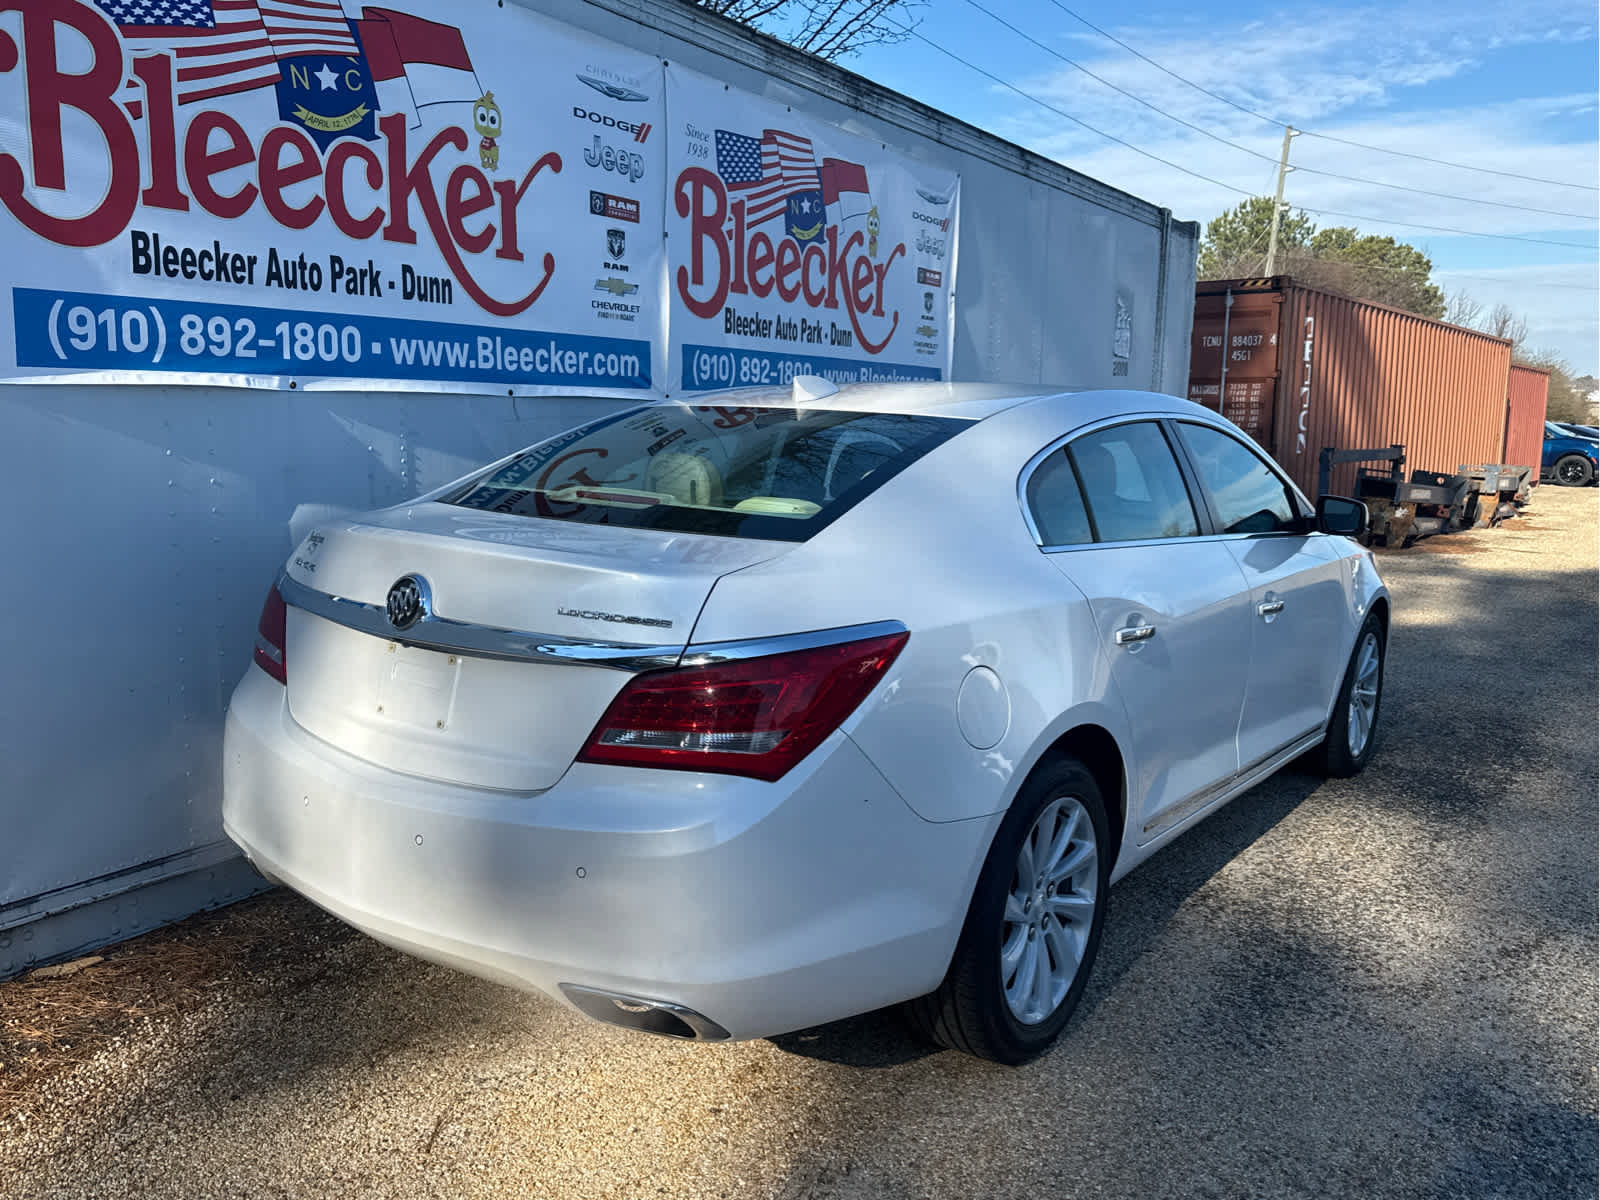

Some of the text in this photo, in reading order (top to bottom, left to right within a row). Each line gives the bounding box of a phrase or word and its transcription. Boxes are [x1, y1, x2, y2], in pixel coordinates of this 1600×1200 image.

[573, 106, 642, 135] DODGE
[685, 123, 709, 143] Since
[0, 0, 563, 317] Bleecker
[583, 134, 645, 183] Jeep
[687, 142, 709, 160] 1938
[607, 198, 638, 213] RAM
[912, 211, 945, 227] DODGE
[131, 230, 258, 285] Bleecker
[265, 248, 323, 292] Auto
[330, 254, 383, 298] Park
[401, 263, 453, 305] Dunn
[603, 262, 629, 272] RAM
[674, 167, 906, 354] Bleecker
[591, 300, 641, 314] CHEVROLET
[48, 299, 640, 377] (910) 892-1800 www.Bleecker.com
[724, 307, 772, 338] Bleecker
[775, 314, 798, 342] Auto
[801, 318, 823, 345] Park
[830, 322, 853, 348] Dunn
[1231, 335, 1263, 347] 884037
[1231, 350, 1252, 361] 45G1
[693, 349, 737, 387] (910)
